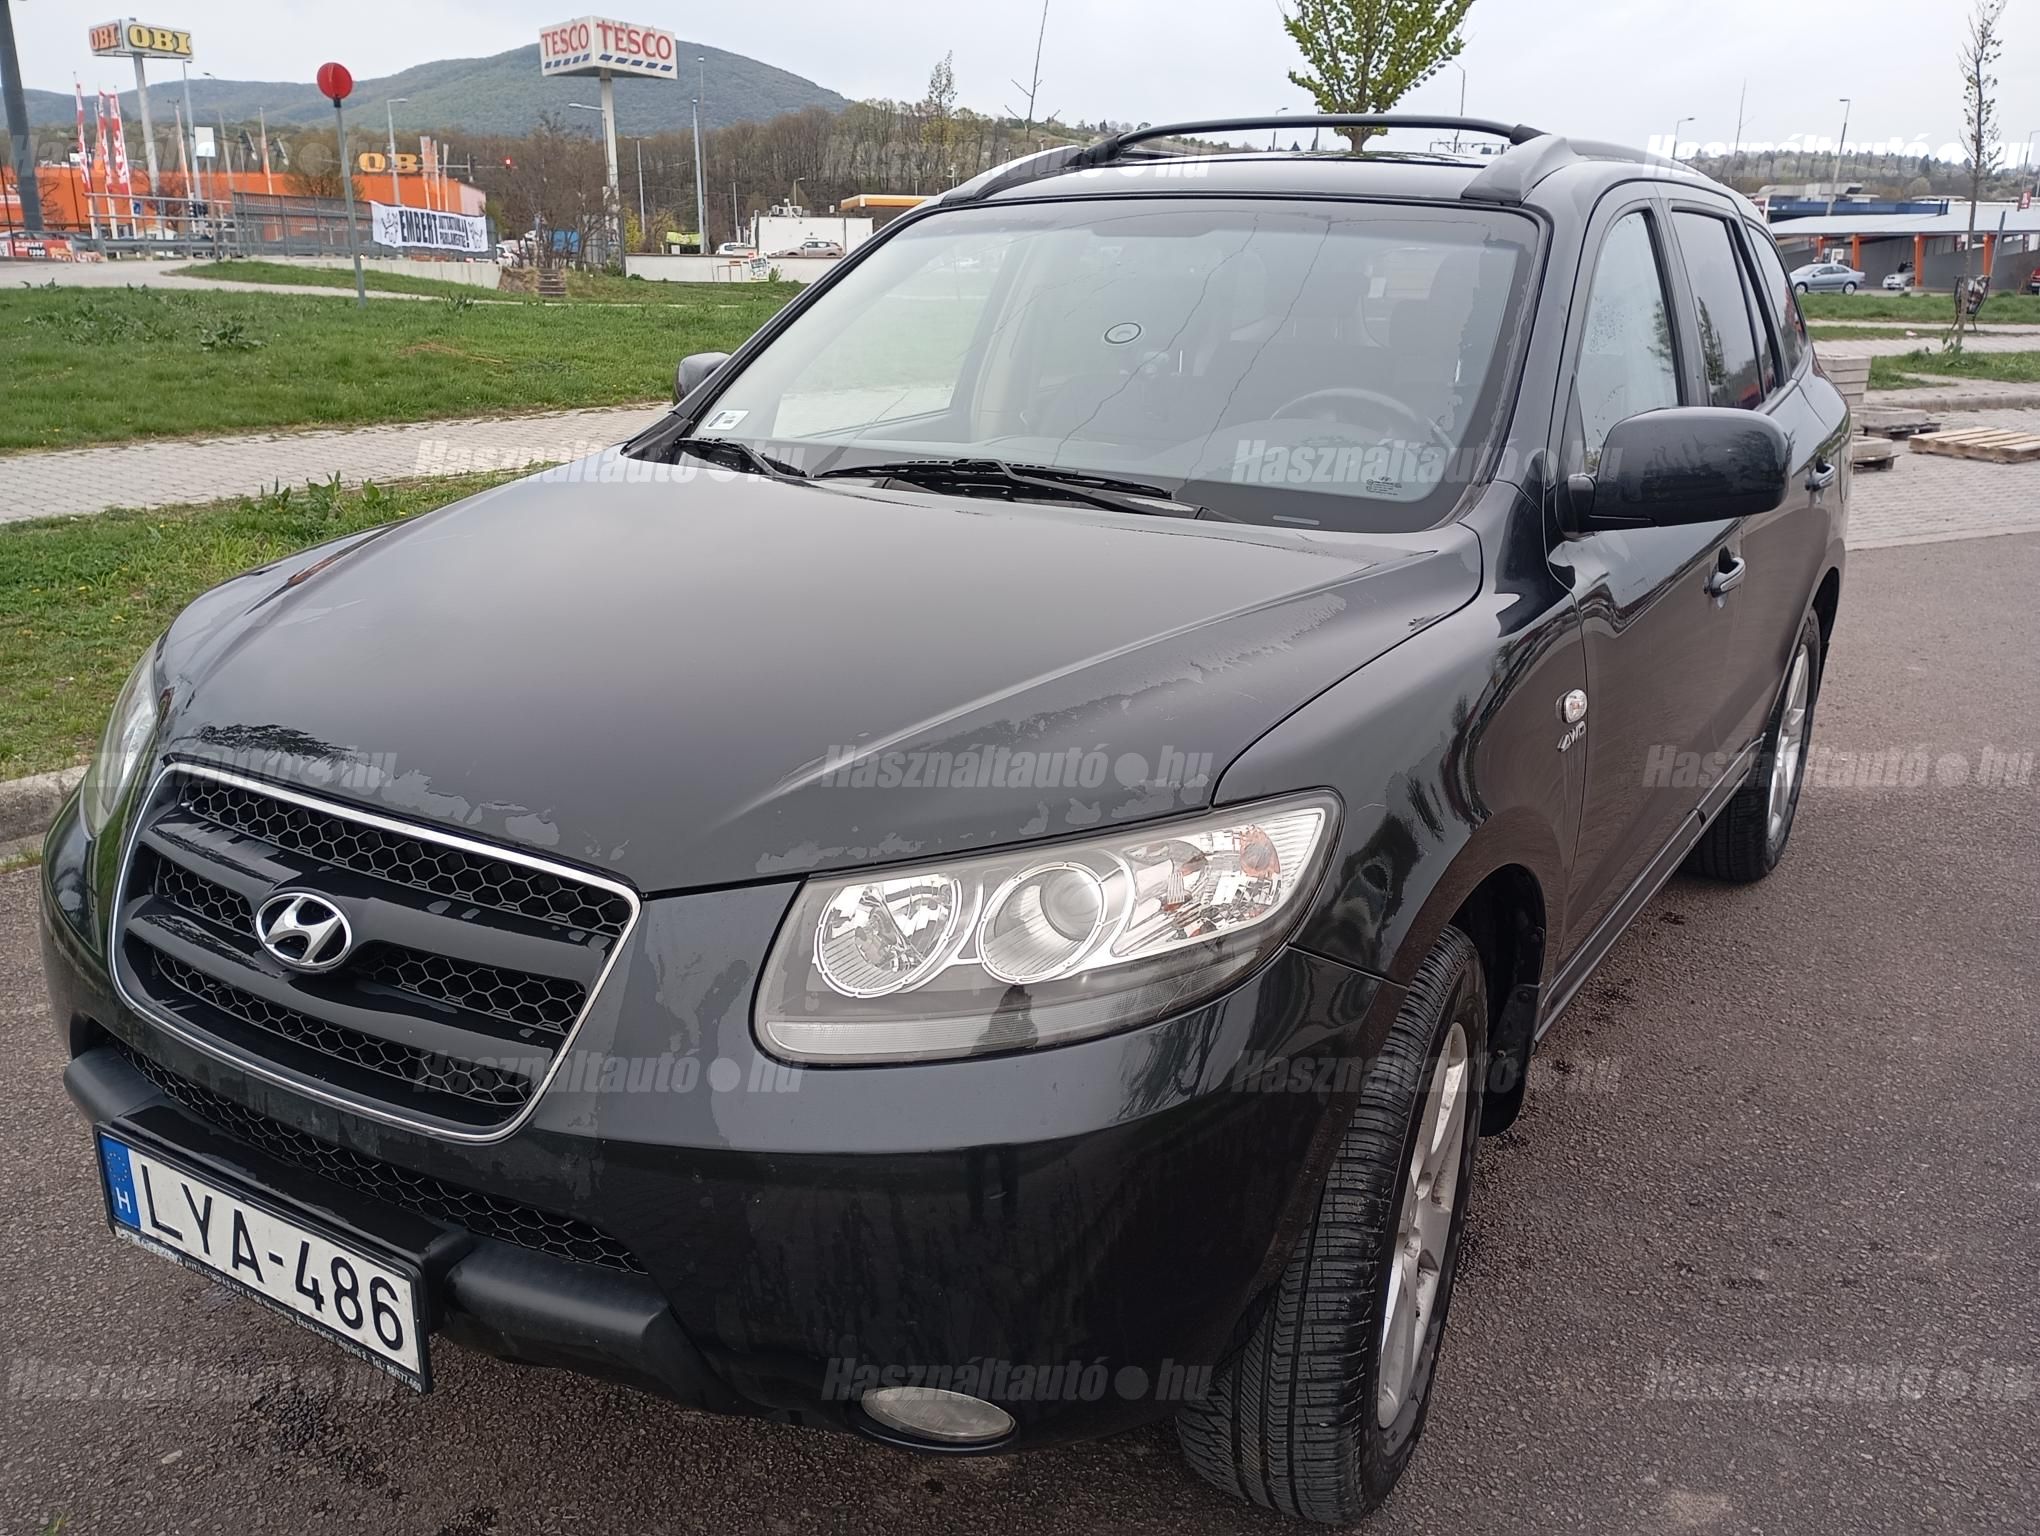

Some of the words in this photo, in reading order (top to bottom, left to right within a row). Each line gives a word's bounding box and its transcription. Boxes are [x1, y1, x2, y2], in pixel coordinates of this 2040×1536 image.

[89, 23, 120, 51] OBI
[127, 24, 192, 55] OBI
[541, 24, 589, 57] TESCO
[596, 22, 672, 60] TESCO
[398, 210, 439, 245] EMBERT
[116, 1186, 131, 1214] H
[140, 1163, 404, 1352] LYA-486
